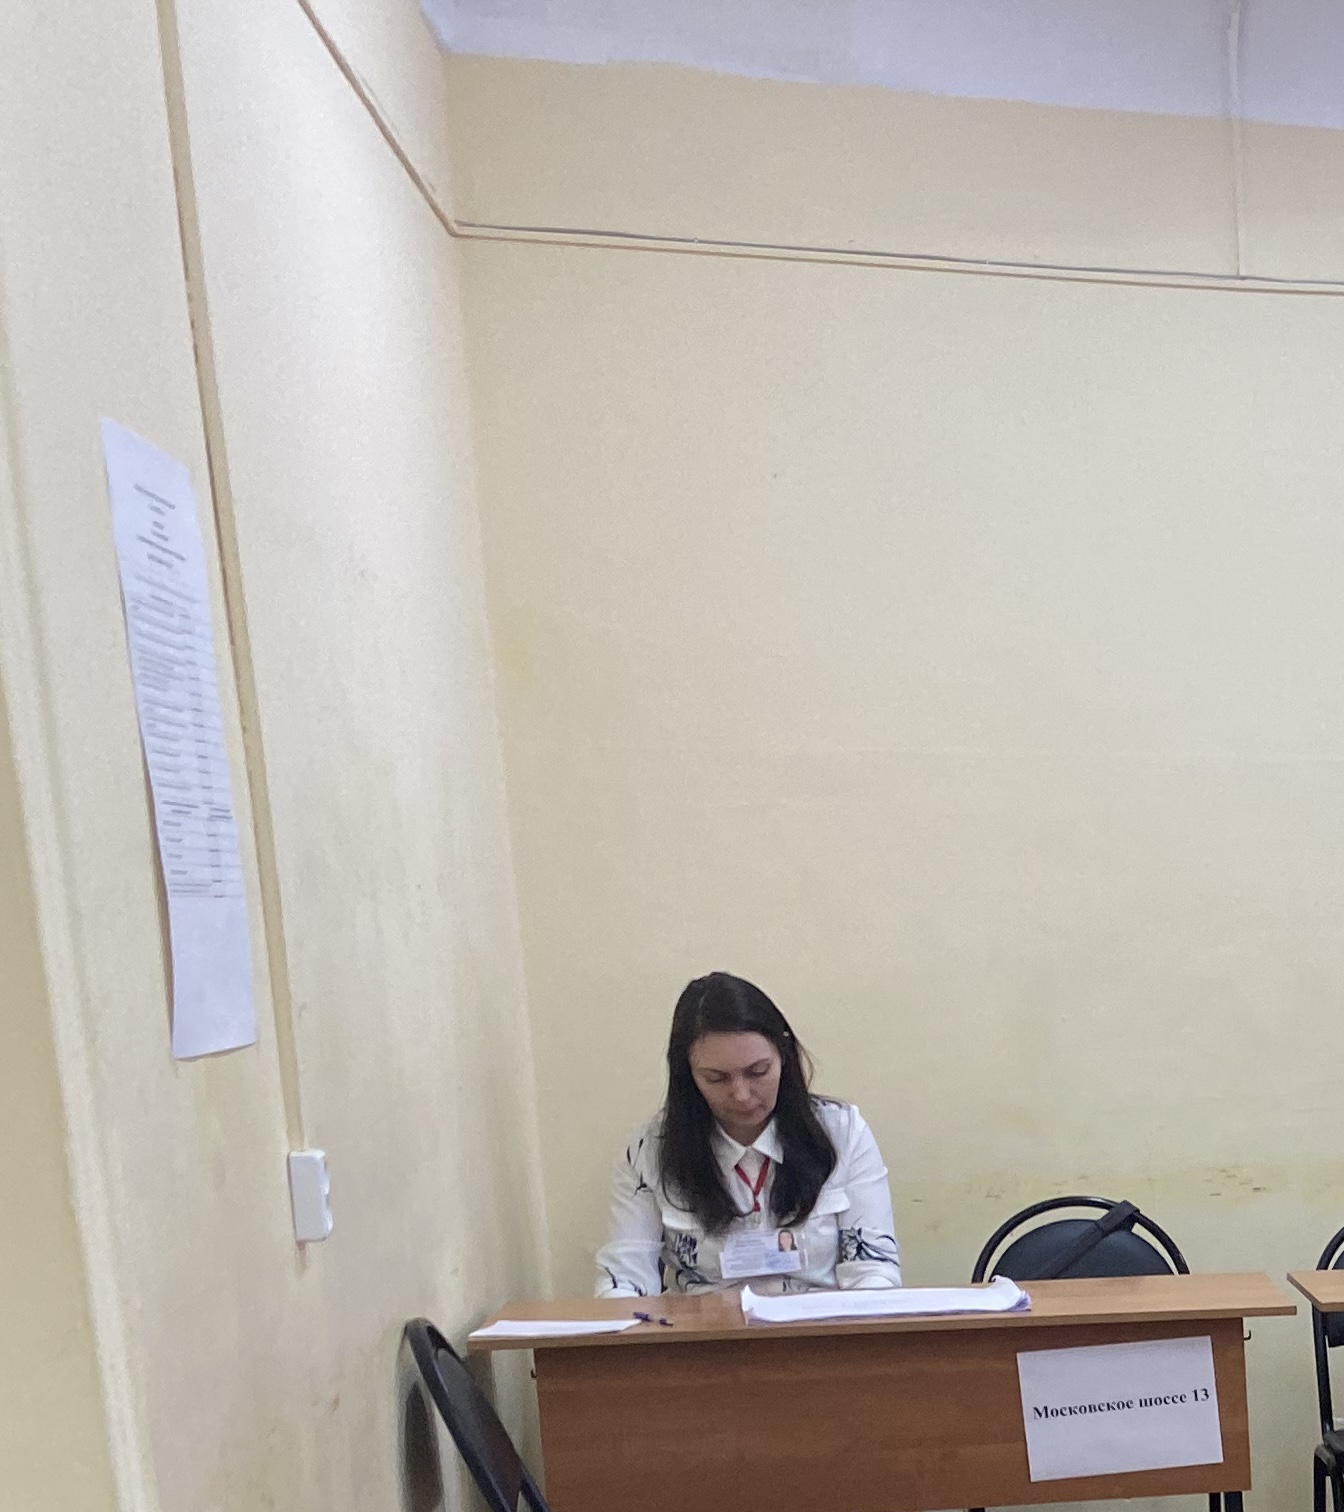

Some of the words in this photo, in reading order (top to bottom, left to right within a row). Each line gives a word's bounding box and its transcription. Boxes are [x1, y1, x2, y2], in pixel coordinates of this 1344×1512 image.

[1033, 1400, 1134, 1420] Московское
[1139, 1393, 1188, 1408] шоссе
[1192, 1388, 1210, 1402] 13
